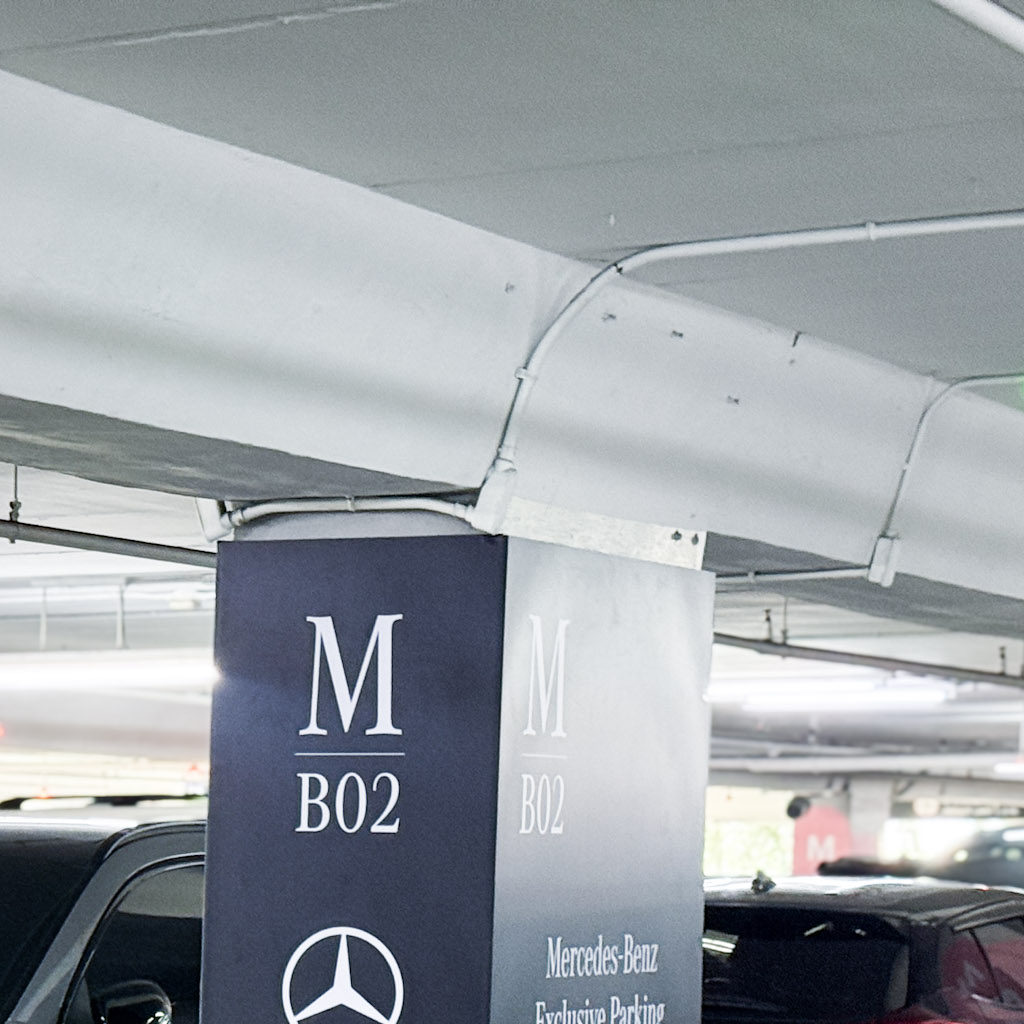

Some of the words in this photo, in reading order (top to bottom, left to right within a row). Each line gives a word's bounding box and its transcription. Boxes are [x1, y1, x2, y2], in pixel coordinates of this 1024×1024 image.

[298, 613, 403, 737] M
[522, 614, 571, 738] M
[295, 772, 401, 834] B02
[519, 774, 565, 835] B02
[806, 834, 836, 859] M
[545, 934, 659, 980] Mercedes-Benz
